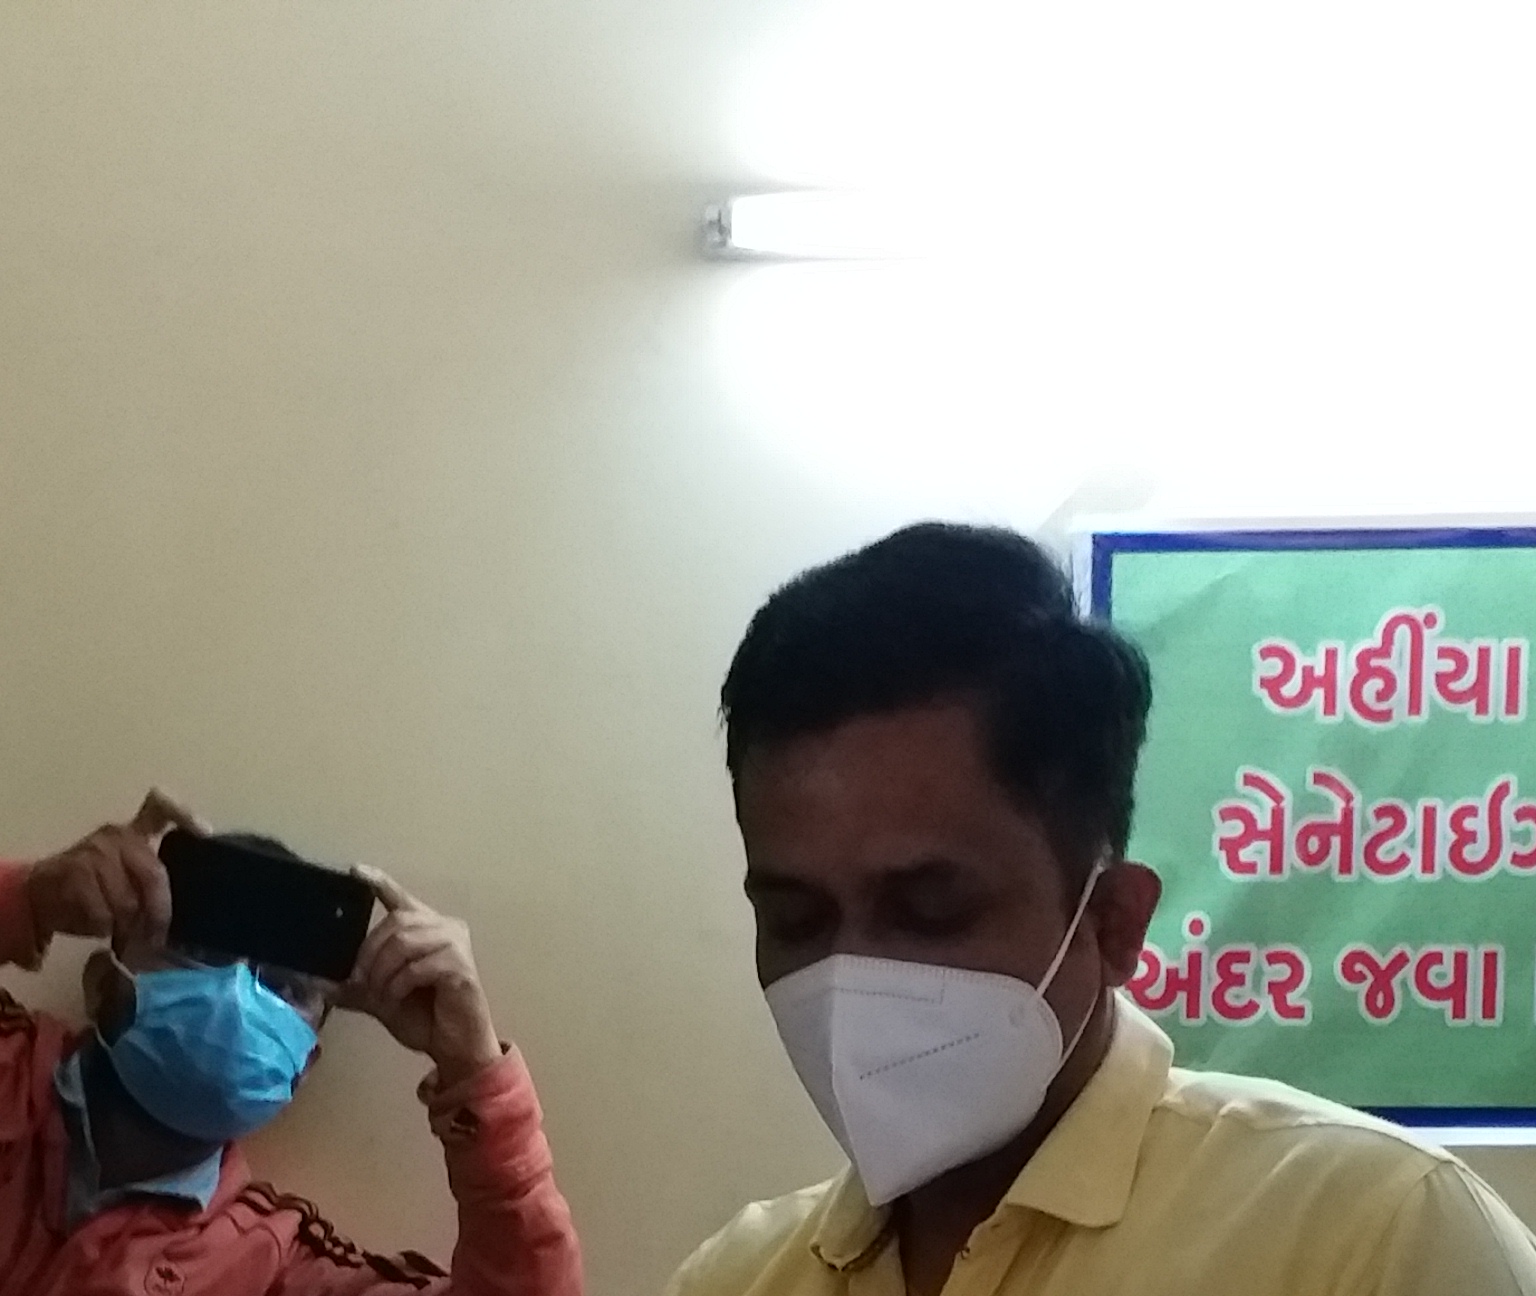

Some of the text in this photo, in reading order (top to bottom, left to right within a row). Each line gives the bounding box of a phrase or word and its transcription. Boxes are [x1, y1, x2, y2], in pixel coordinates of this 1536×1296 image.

[1260, 612, 1520, 722] અહીંયા
[1126, 917, 1304, 1019] અંદર
[1341, 950, 1497, 1019] જવા
